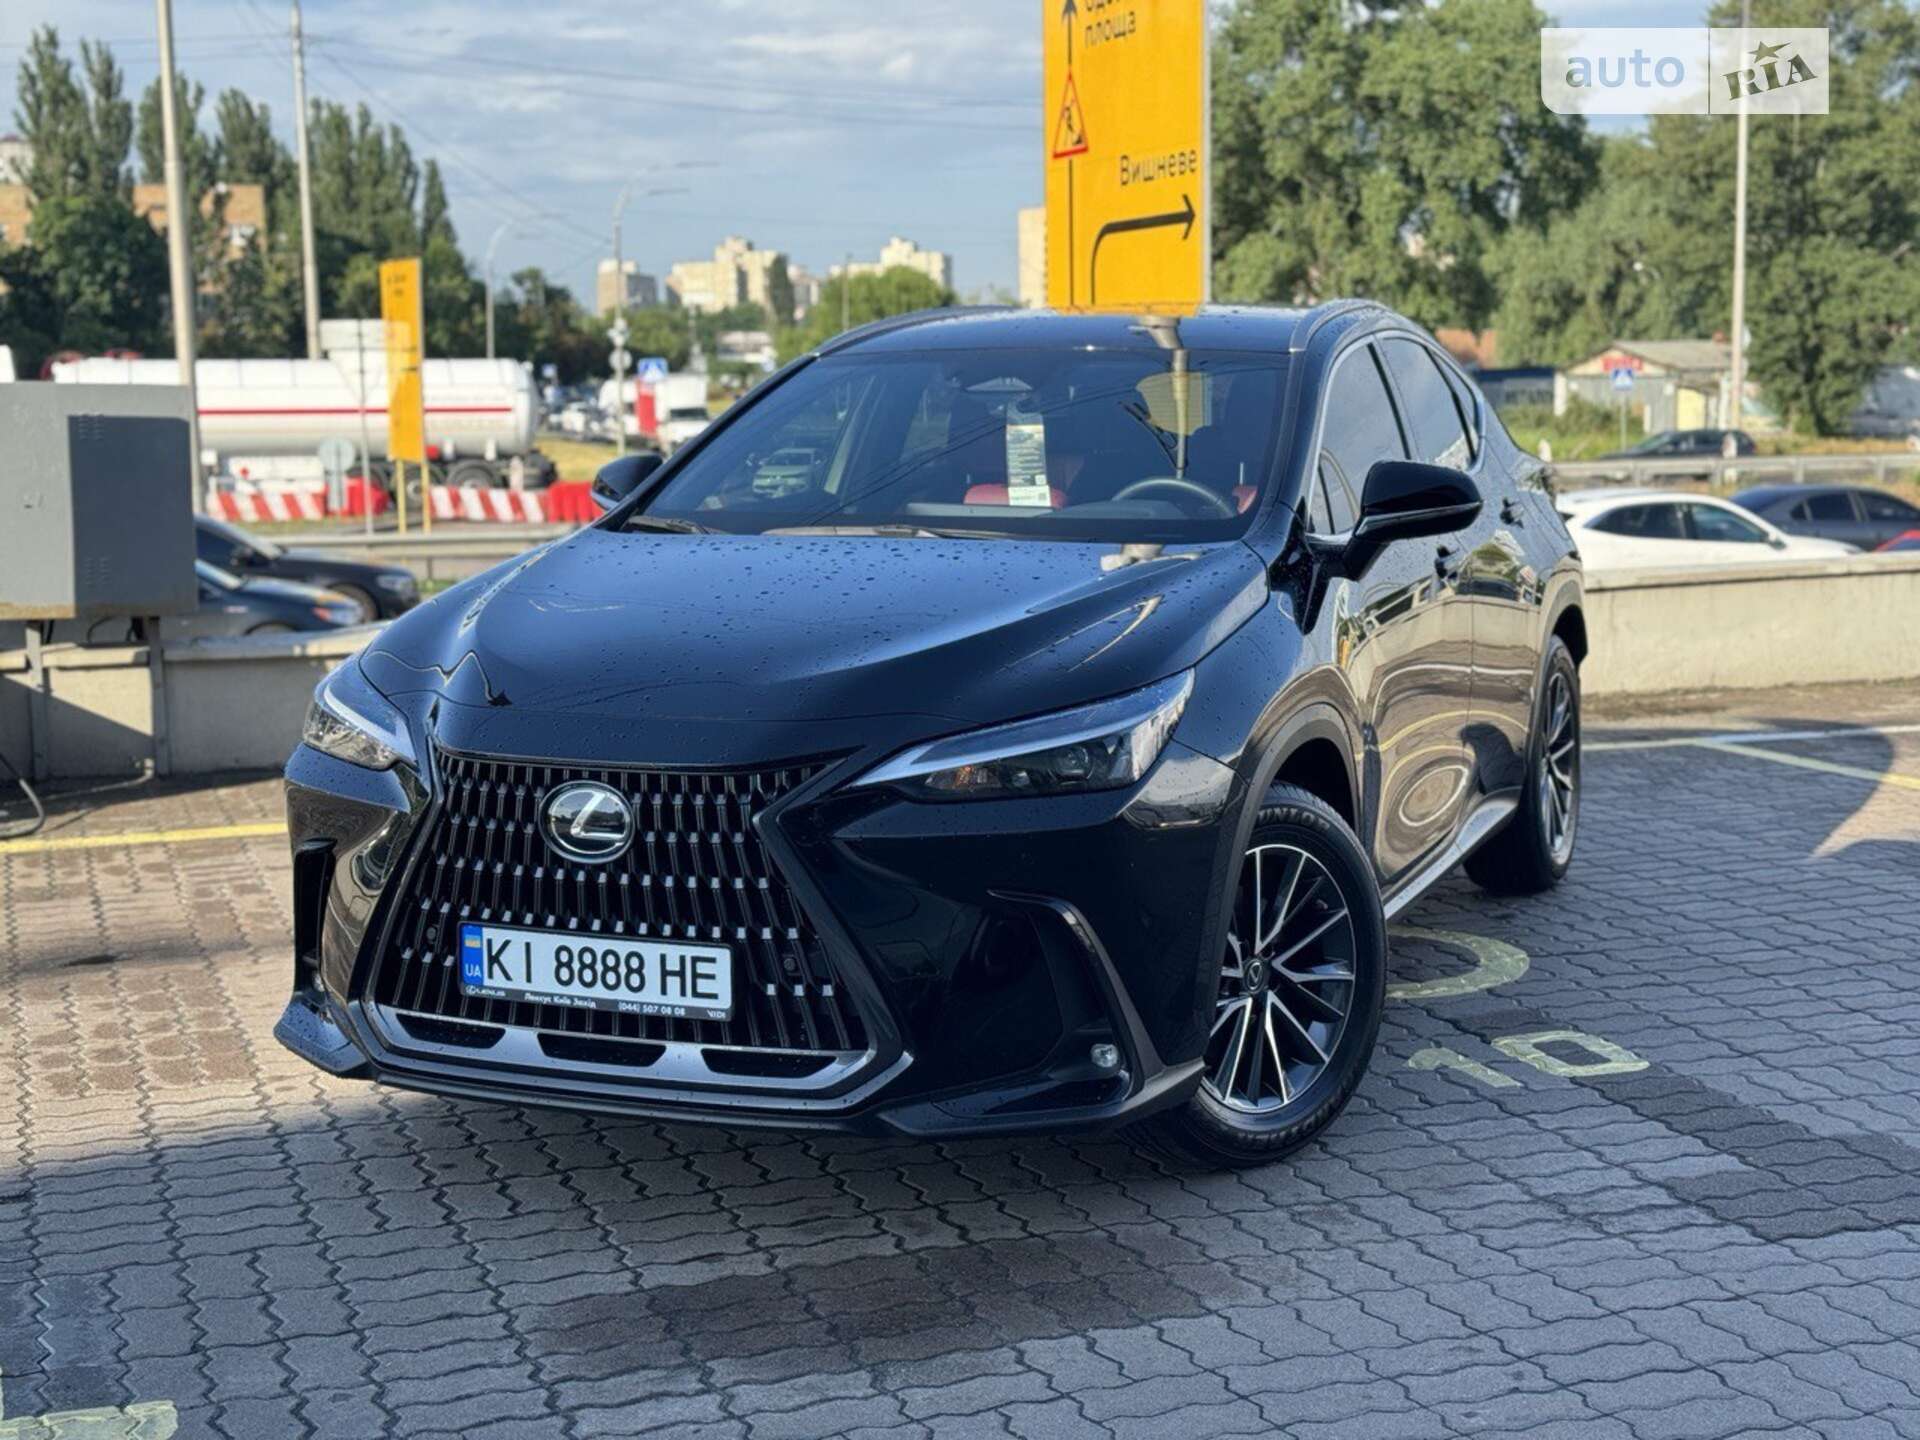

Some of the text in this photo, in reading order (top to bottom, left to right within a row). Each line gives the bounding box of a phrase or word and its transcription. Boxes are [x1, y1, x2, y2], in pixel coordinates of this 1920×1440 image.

[1085, 12, 1136, 47] площа
[1120, 150, 1197, 186] Вишневе
[1258, 807, 1330, 831] UNLOP
[465, 963, 482, 978] UA
[486, 938, 719, 1000] KI 8888 HE
[643, 1004, 658, 1013] 507
